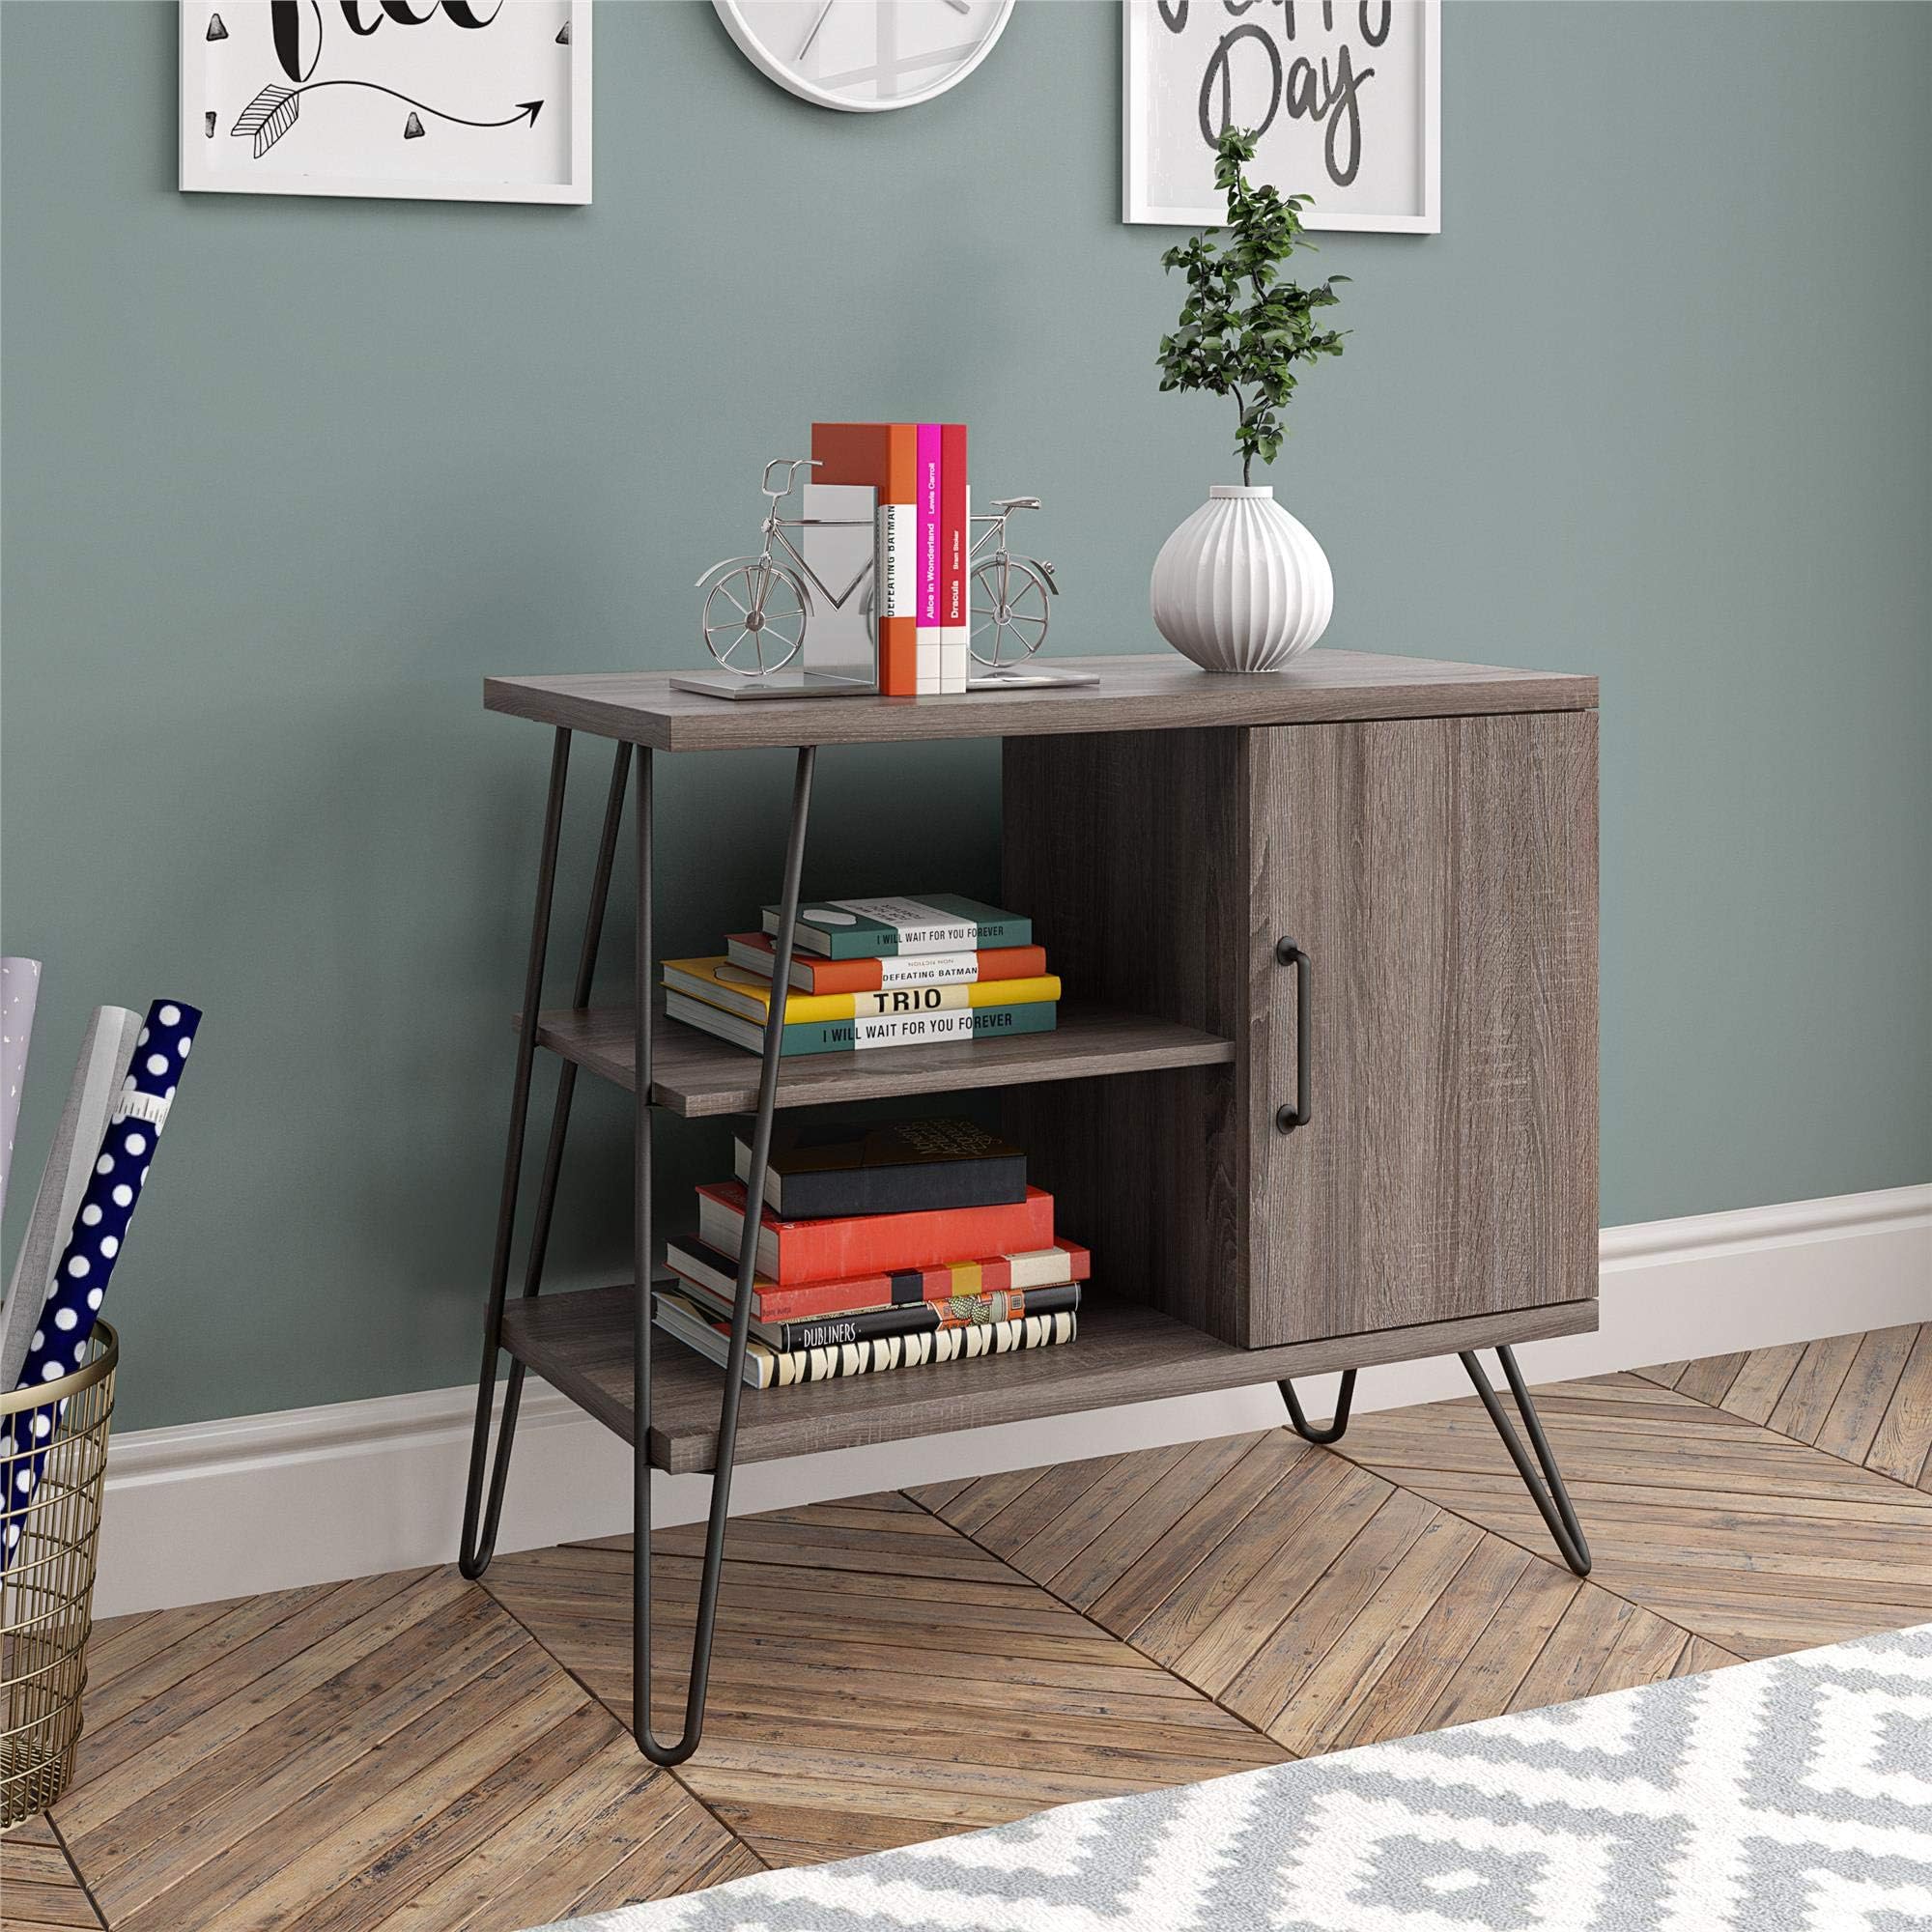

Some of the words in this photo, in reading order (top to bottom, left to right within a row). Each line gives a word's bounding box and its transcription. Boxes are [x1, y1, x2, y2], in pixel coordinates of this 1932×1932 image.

[1199, 24, 1375, 186] Day
[887, 505, 895, 552] BATMAN
[926, 523, 935, 582] Wonderland
[887, 556, 895, 617] DEFEATING
[926, 583, 935, 593] in
[951, 581, 959, 618] Dracula
[926, 594, 935, 619] Alice
[876, 934, 881, 946] I
[883, 933, 903, 945] WILL
[905, 931, 926, 943] WAIT
[929, 930, 946, 941] FOR
[948, 928, 964, 940] YOU
[967, 925, 1004, 938] FOREVER
[883, 970, 935, 981] DEFEATING
[938, 967, 978, 978] BATMAN
[873, 988, 942, 1013] TRIO
[823, 1030, 827, 1043] I
[832, 1027, 862, 1042] WILL
[866, 1024, 897, 1039] WAIT
[902, 1021, 925, 1036] FOR
[930, 1018, 953, 1033] YOU
[958, 1012, 1012, 1031] FOREVER
[804, 1322, 856, 1348] DUBLINERS
